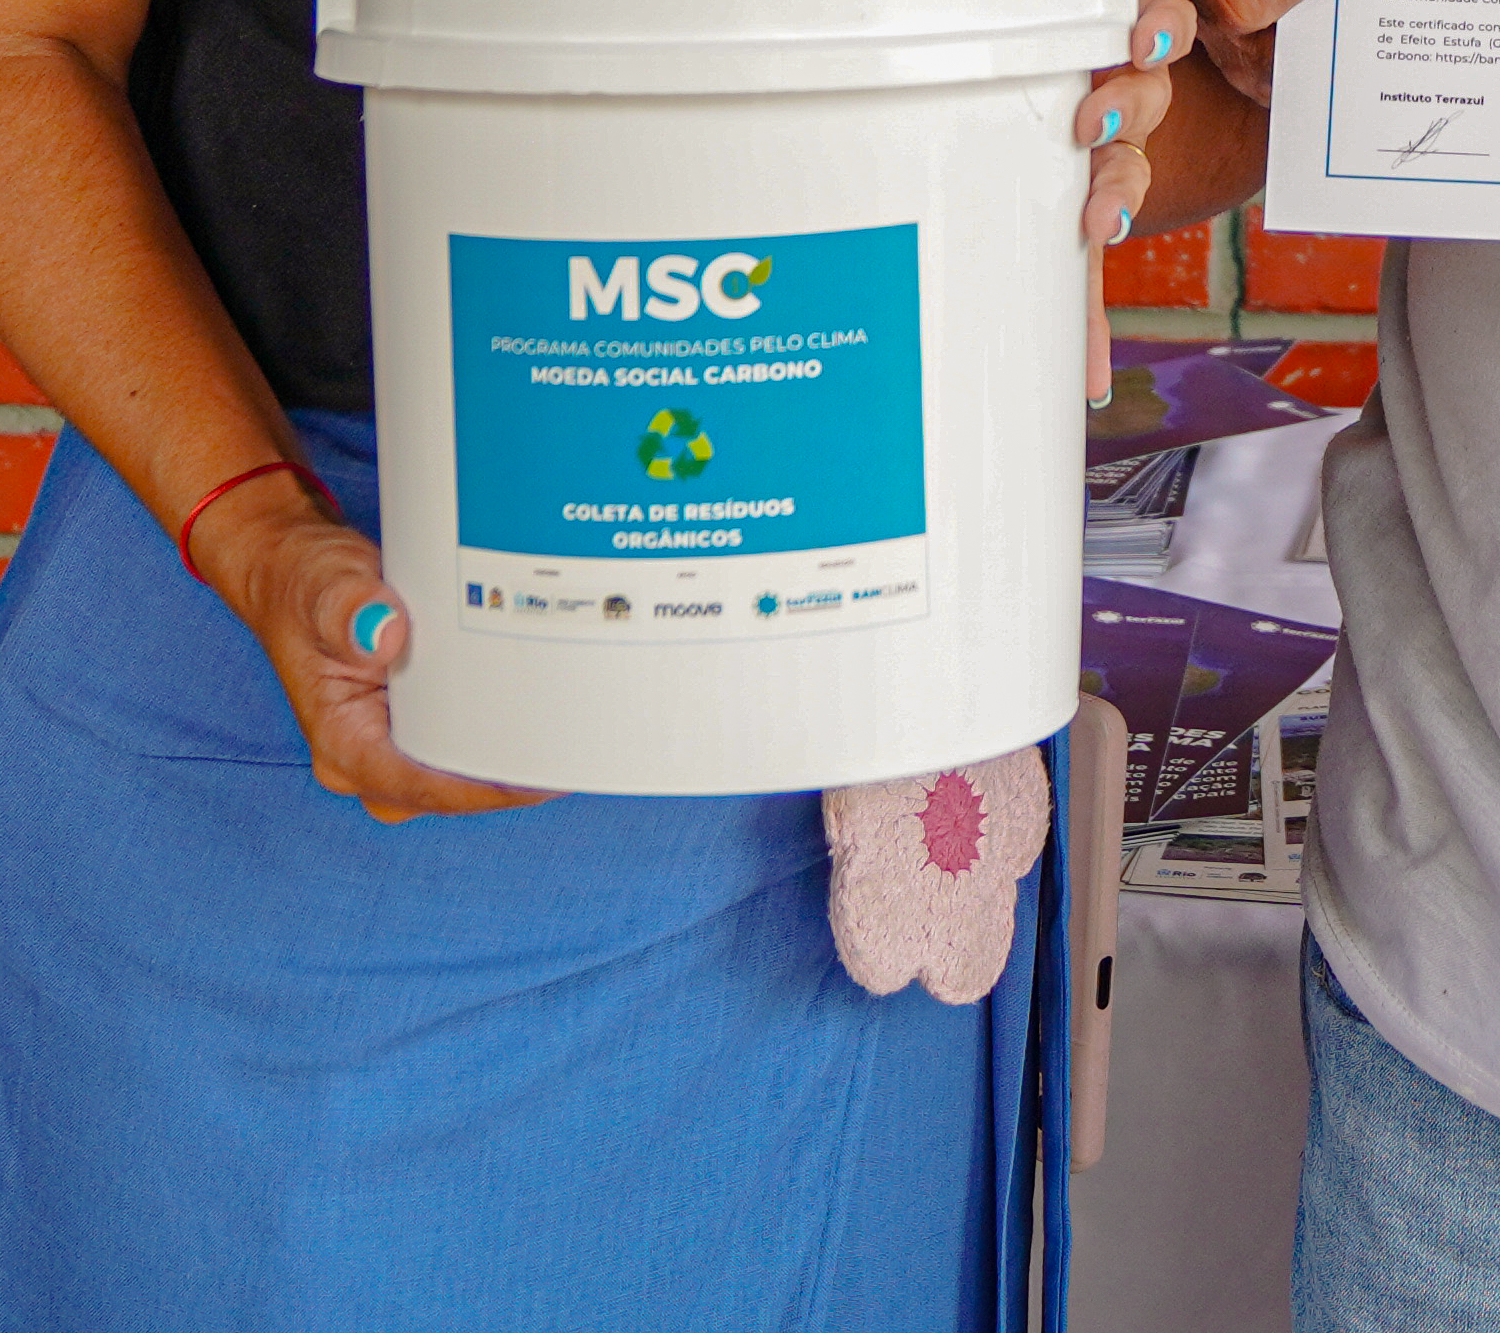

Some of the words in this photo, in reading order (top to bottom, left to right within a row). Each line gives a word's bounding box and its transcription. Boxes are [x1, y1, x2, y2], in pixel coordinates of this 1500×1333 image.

[1380, 91, 1432, 104] Instituto
[1434, 94, 1485, 107] Terrazul
[567, 252, 763, 322] MSC
[490, 335, 591, 358] PROGRAMA
[593, 336, 747, 359] COMUNIDADES
[749, 332, 805, 355] PELO
[806, 327, 869, 351] CLIMA
[530, 365, 611, 387] MOEDA
[613, 365, 699, 388] SOCIAL
[702, 357, 823, 387] CARBONO
[562, 502, 645, 523] COLETA
[648, 502, 679, 524] DE
[683, 496, 795, 522] RESÍDUOS
[611, 526, 743, 551] ORGÂNICOS
[654, 602, 723, 617] moove
